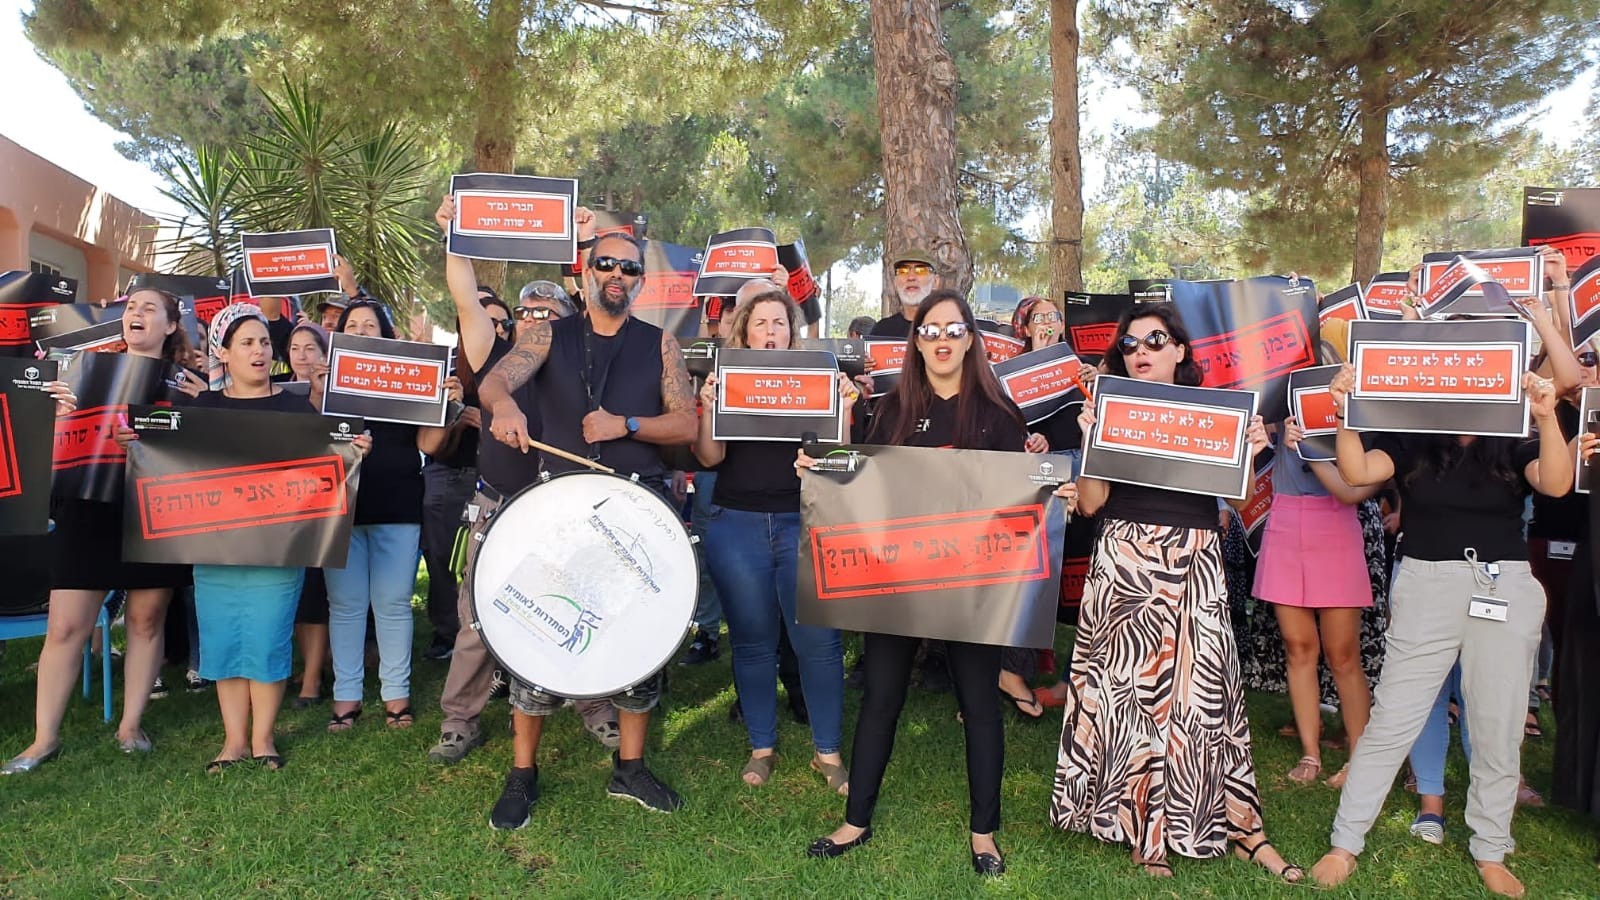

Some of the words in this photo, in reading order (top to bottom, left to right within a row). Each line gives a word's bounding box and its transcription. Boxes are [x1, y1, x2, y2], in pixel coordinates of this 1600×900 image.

[477, 216, 501, 227] יותר!
[504, 217, 525, 228] שווה
[528, 219, 544, 228] אני
[1387, 354, 1417, 366] נעים
[1422, 352, 1440, 366] לא
[1444, 353, 1461, 366] לא
[1466, 353, 1485, 366] לא
[356, 362, 377, 372] נעים
[380, 362, 392, 373] לא
[394, 364, 406, 375] לא
[409, 366, 420, 377] לא
[341, 375, 371, 386] תנאים!
[374, 377, 388, 387] בלי
[755, 379, 782, 388] תנאים
[790, 377, 801, 388] בלי
[1367, 374, 1409, 386] תנאים!
[1414, 371, 1436, 386] בלי
[1440, 376, 1458, 387] פה
[1463, 373, 1505, 388] לעבוד
[391, 381, 403, 389] פה
[406, 382, 432, 393] לעבוד
[745, 395, 778, 405] עובד!!!
[781, 393, 792, 404] לא
[795, 396, 806, 405] זה
[1128, 409, 1155, 422] נעים
[1160, 412, 1175, 425] לא
[1179, 414, 1194, 427] לא
[1198, 415, 1214, 429] לא
[1107, 426, 1146, 441] תנאים!
[1150, 430, 1169, 444] בלי
[1173, 435, 1189, 447] פה
[1194, 438, 1230, 452] לעבוד
[234, 482, 275, 503] אני
[285, 476, 333, 503] כמה
[153, 490, 223, 514] שווה?
[913, 538, 960, 560] אני
[974, 530, 1032, 557] כמה
[827, 543, 900, 570] שווה?
[504, 583, 535, 609] לאומית
[533, 606, 570, 638] הסתדרות
